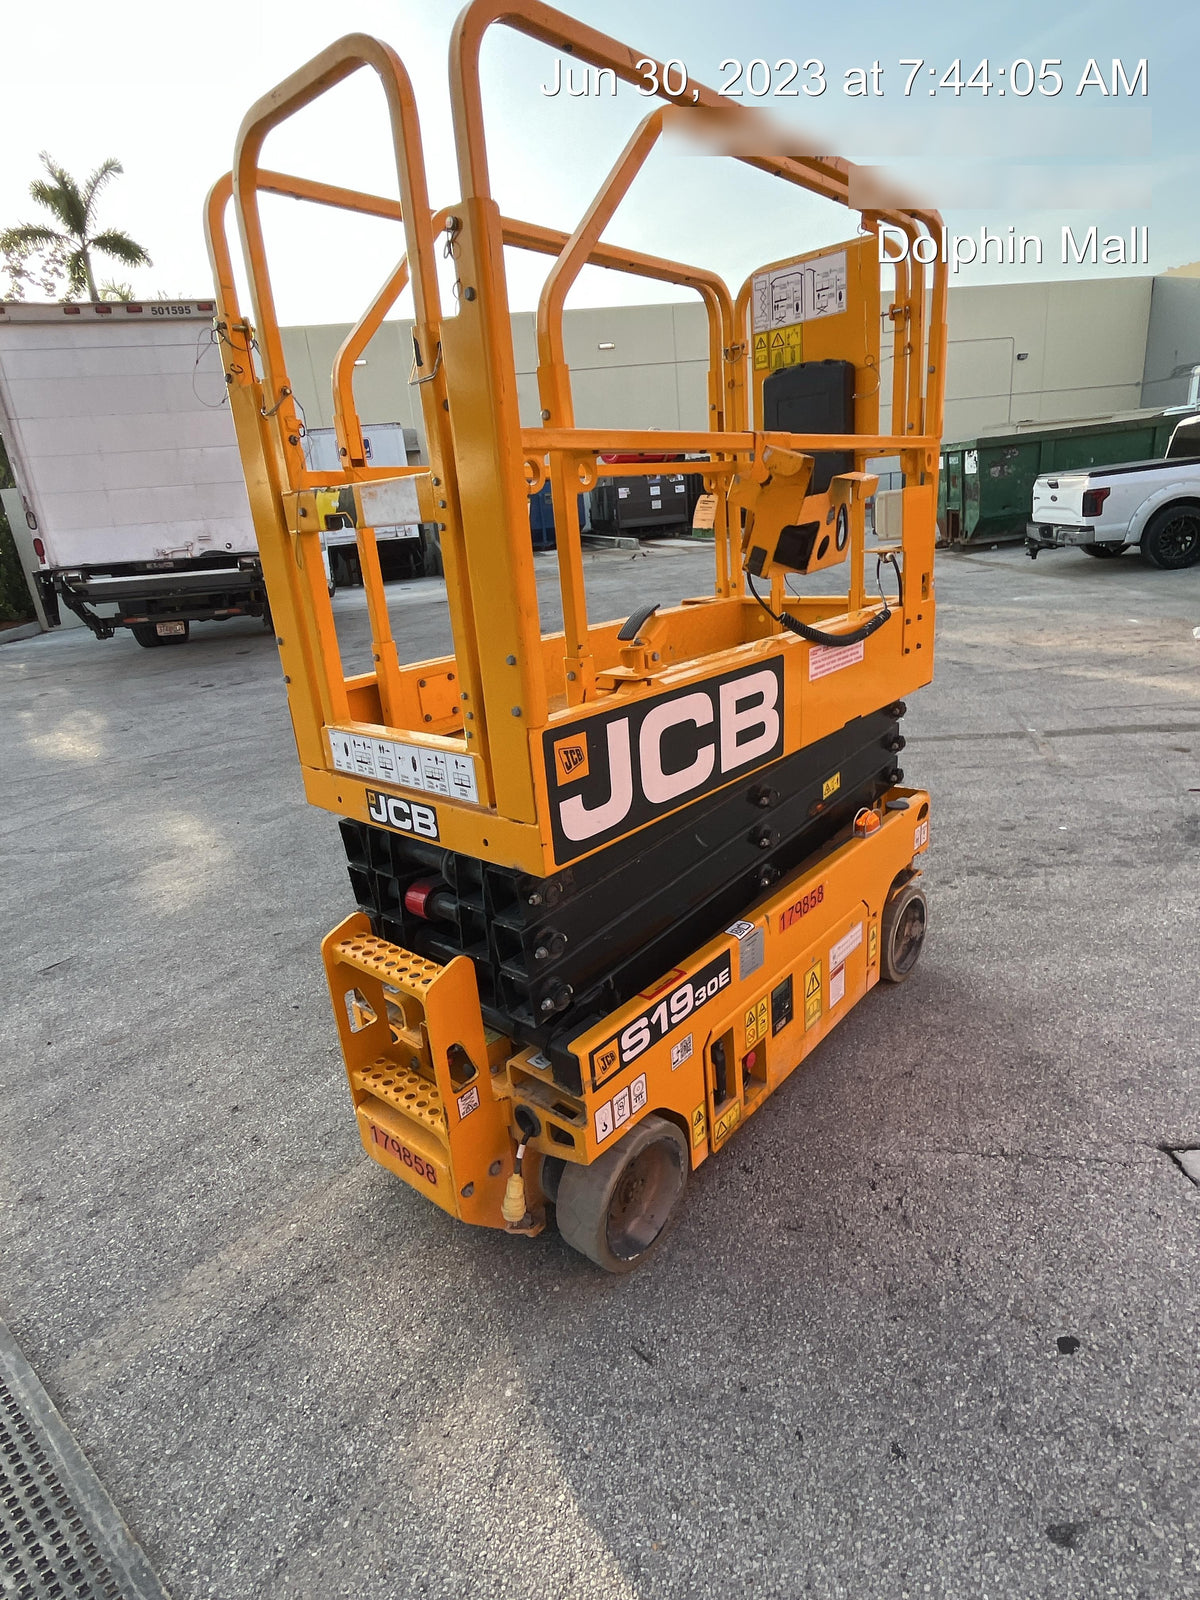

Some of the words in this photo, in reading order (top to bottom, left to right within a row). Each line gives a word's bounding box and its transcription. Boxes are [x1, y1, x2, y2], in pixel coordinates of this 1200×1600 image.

[151, 306, 191, 315] 501595
[559, 669, 780, 842] JCB
[563, 748, 583, 771] JCB
[369, 794, 438, 838] JCB
[780, 885, 824, 931] 179858
[600, 1053, 616, 1071] JCB
[371, 1125, 437, 1185] 179858
